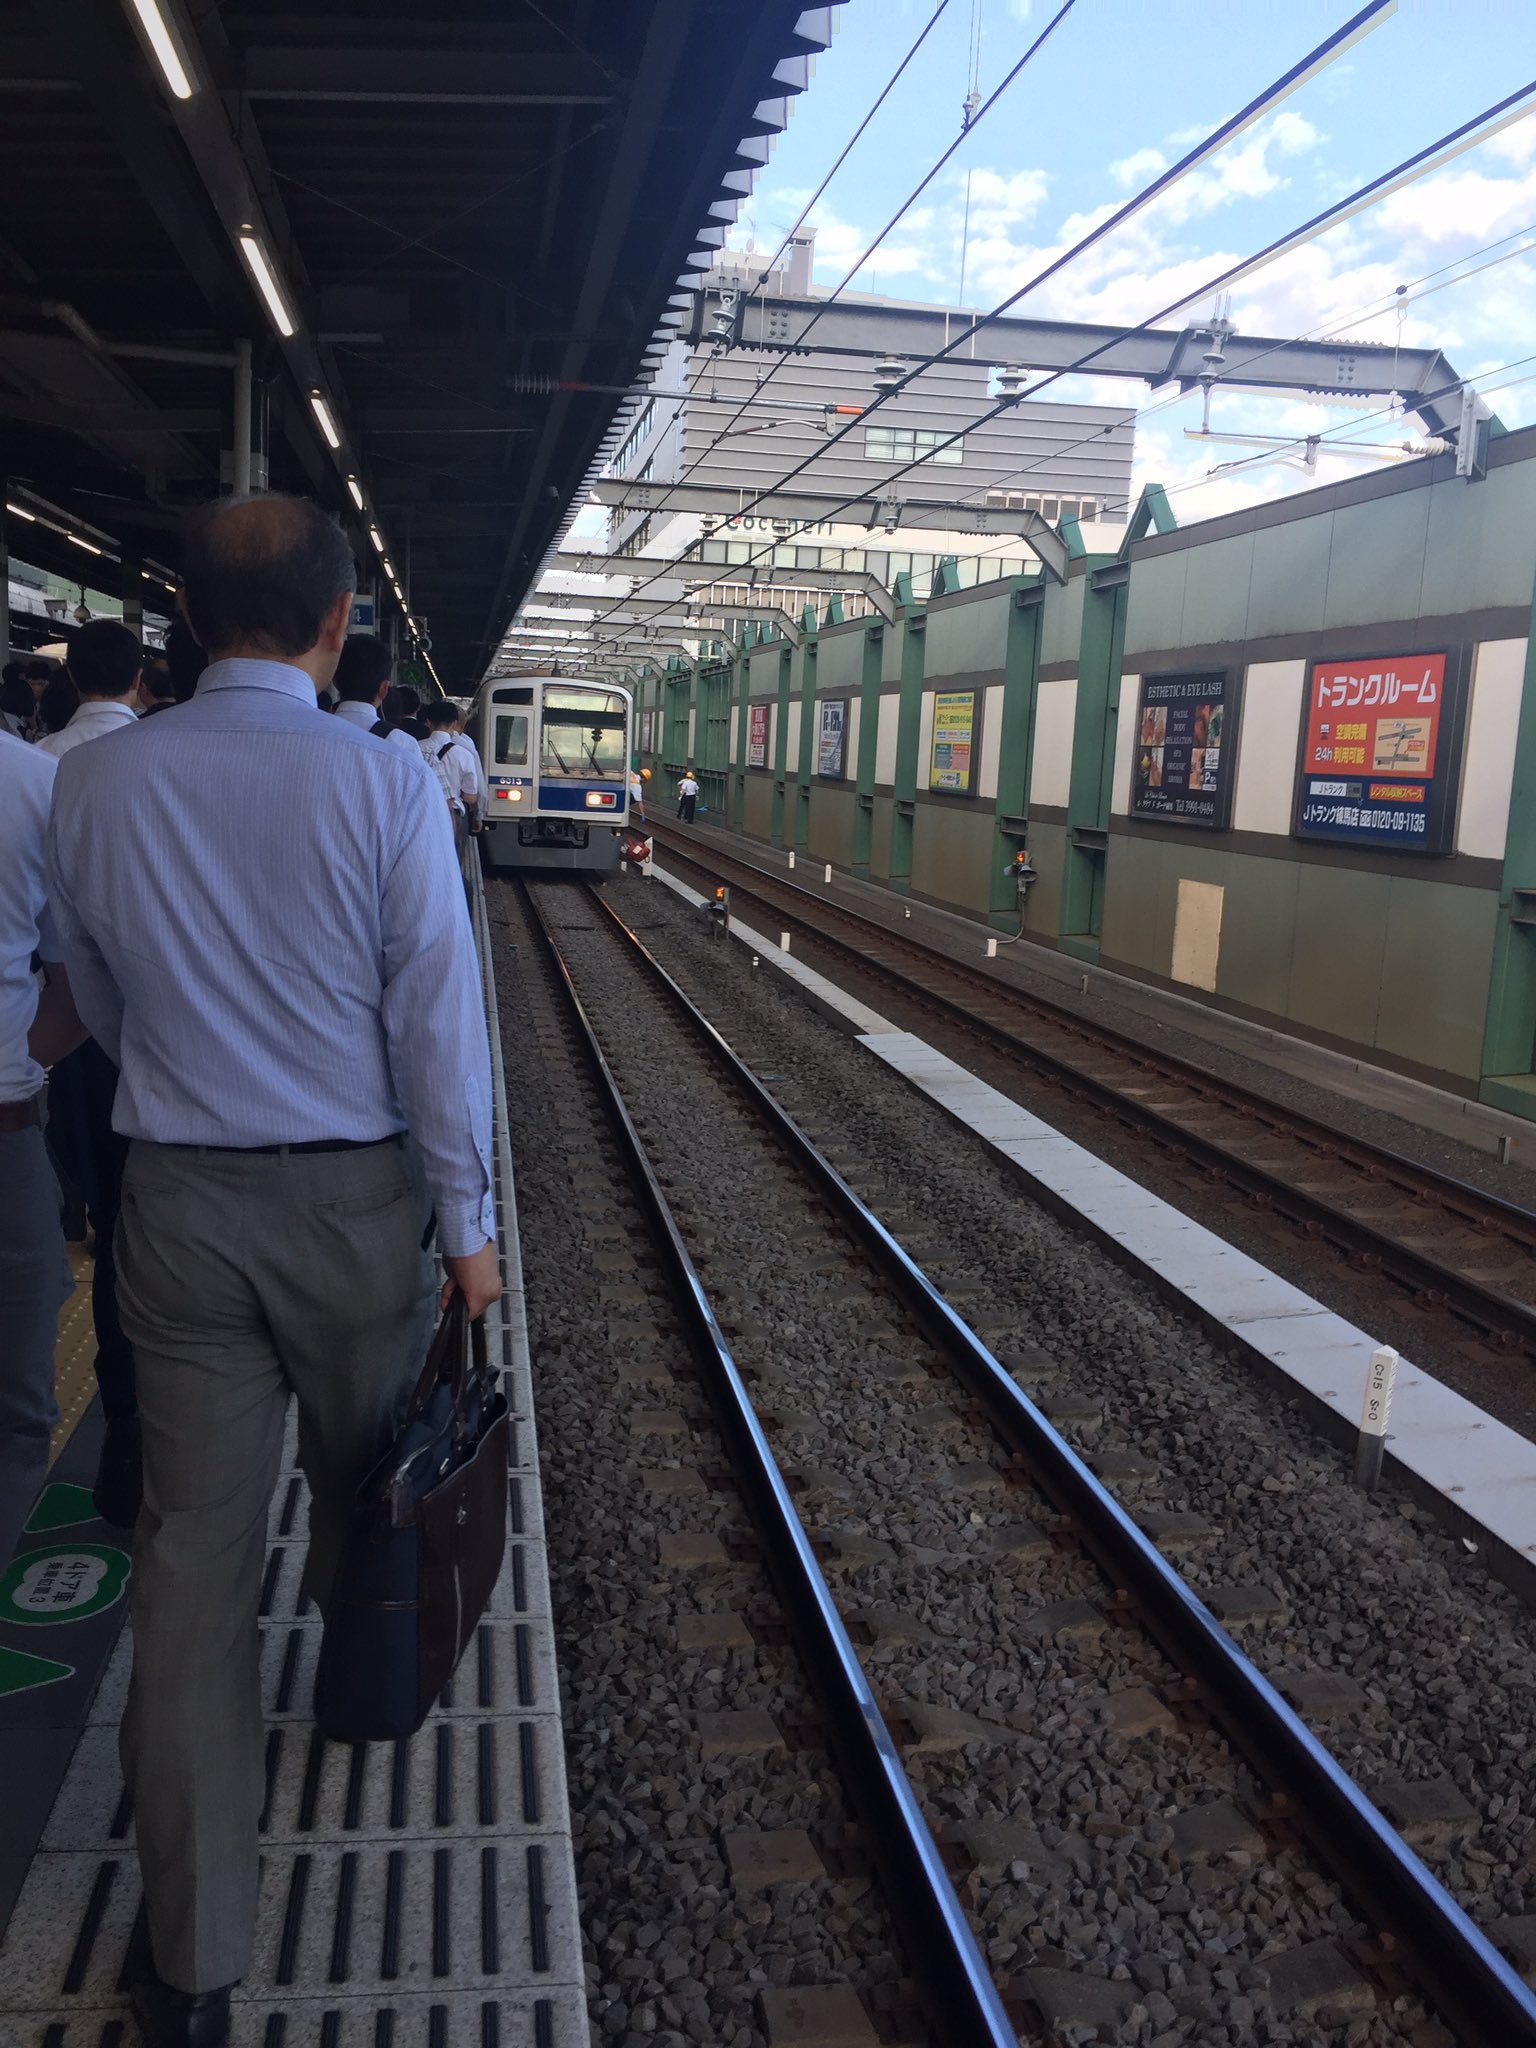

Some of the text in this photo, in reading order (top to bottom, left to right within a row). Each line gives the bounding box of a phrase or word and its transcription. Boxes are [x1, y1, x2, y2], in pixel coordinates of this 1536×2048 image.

[1148, 682, 1222, 699] ESTHETIC & EYE LASH
[1317, 669, 1437, 708] トランクルーム
[1336, 723, 1367, 740] 空調完備
[1315, 746, 1366, 764] 24h 利用可能
[499, 777, 522, 785] 6013
[1370, 786, 1423, 799] レンタル収納スペース
[1371, 810, 1426, 833] 0120-09-1135
[52, 1561, 90, 1603] 4ドア車
